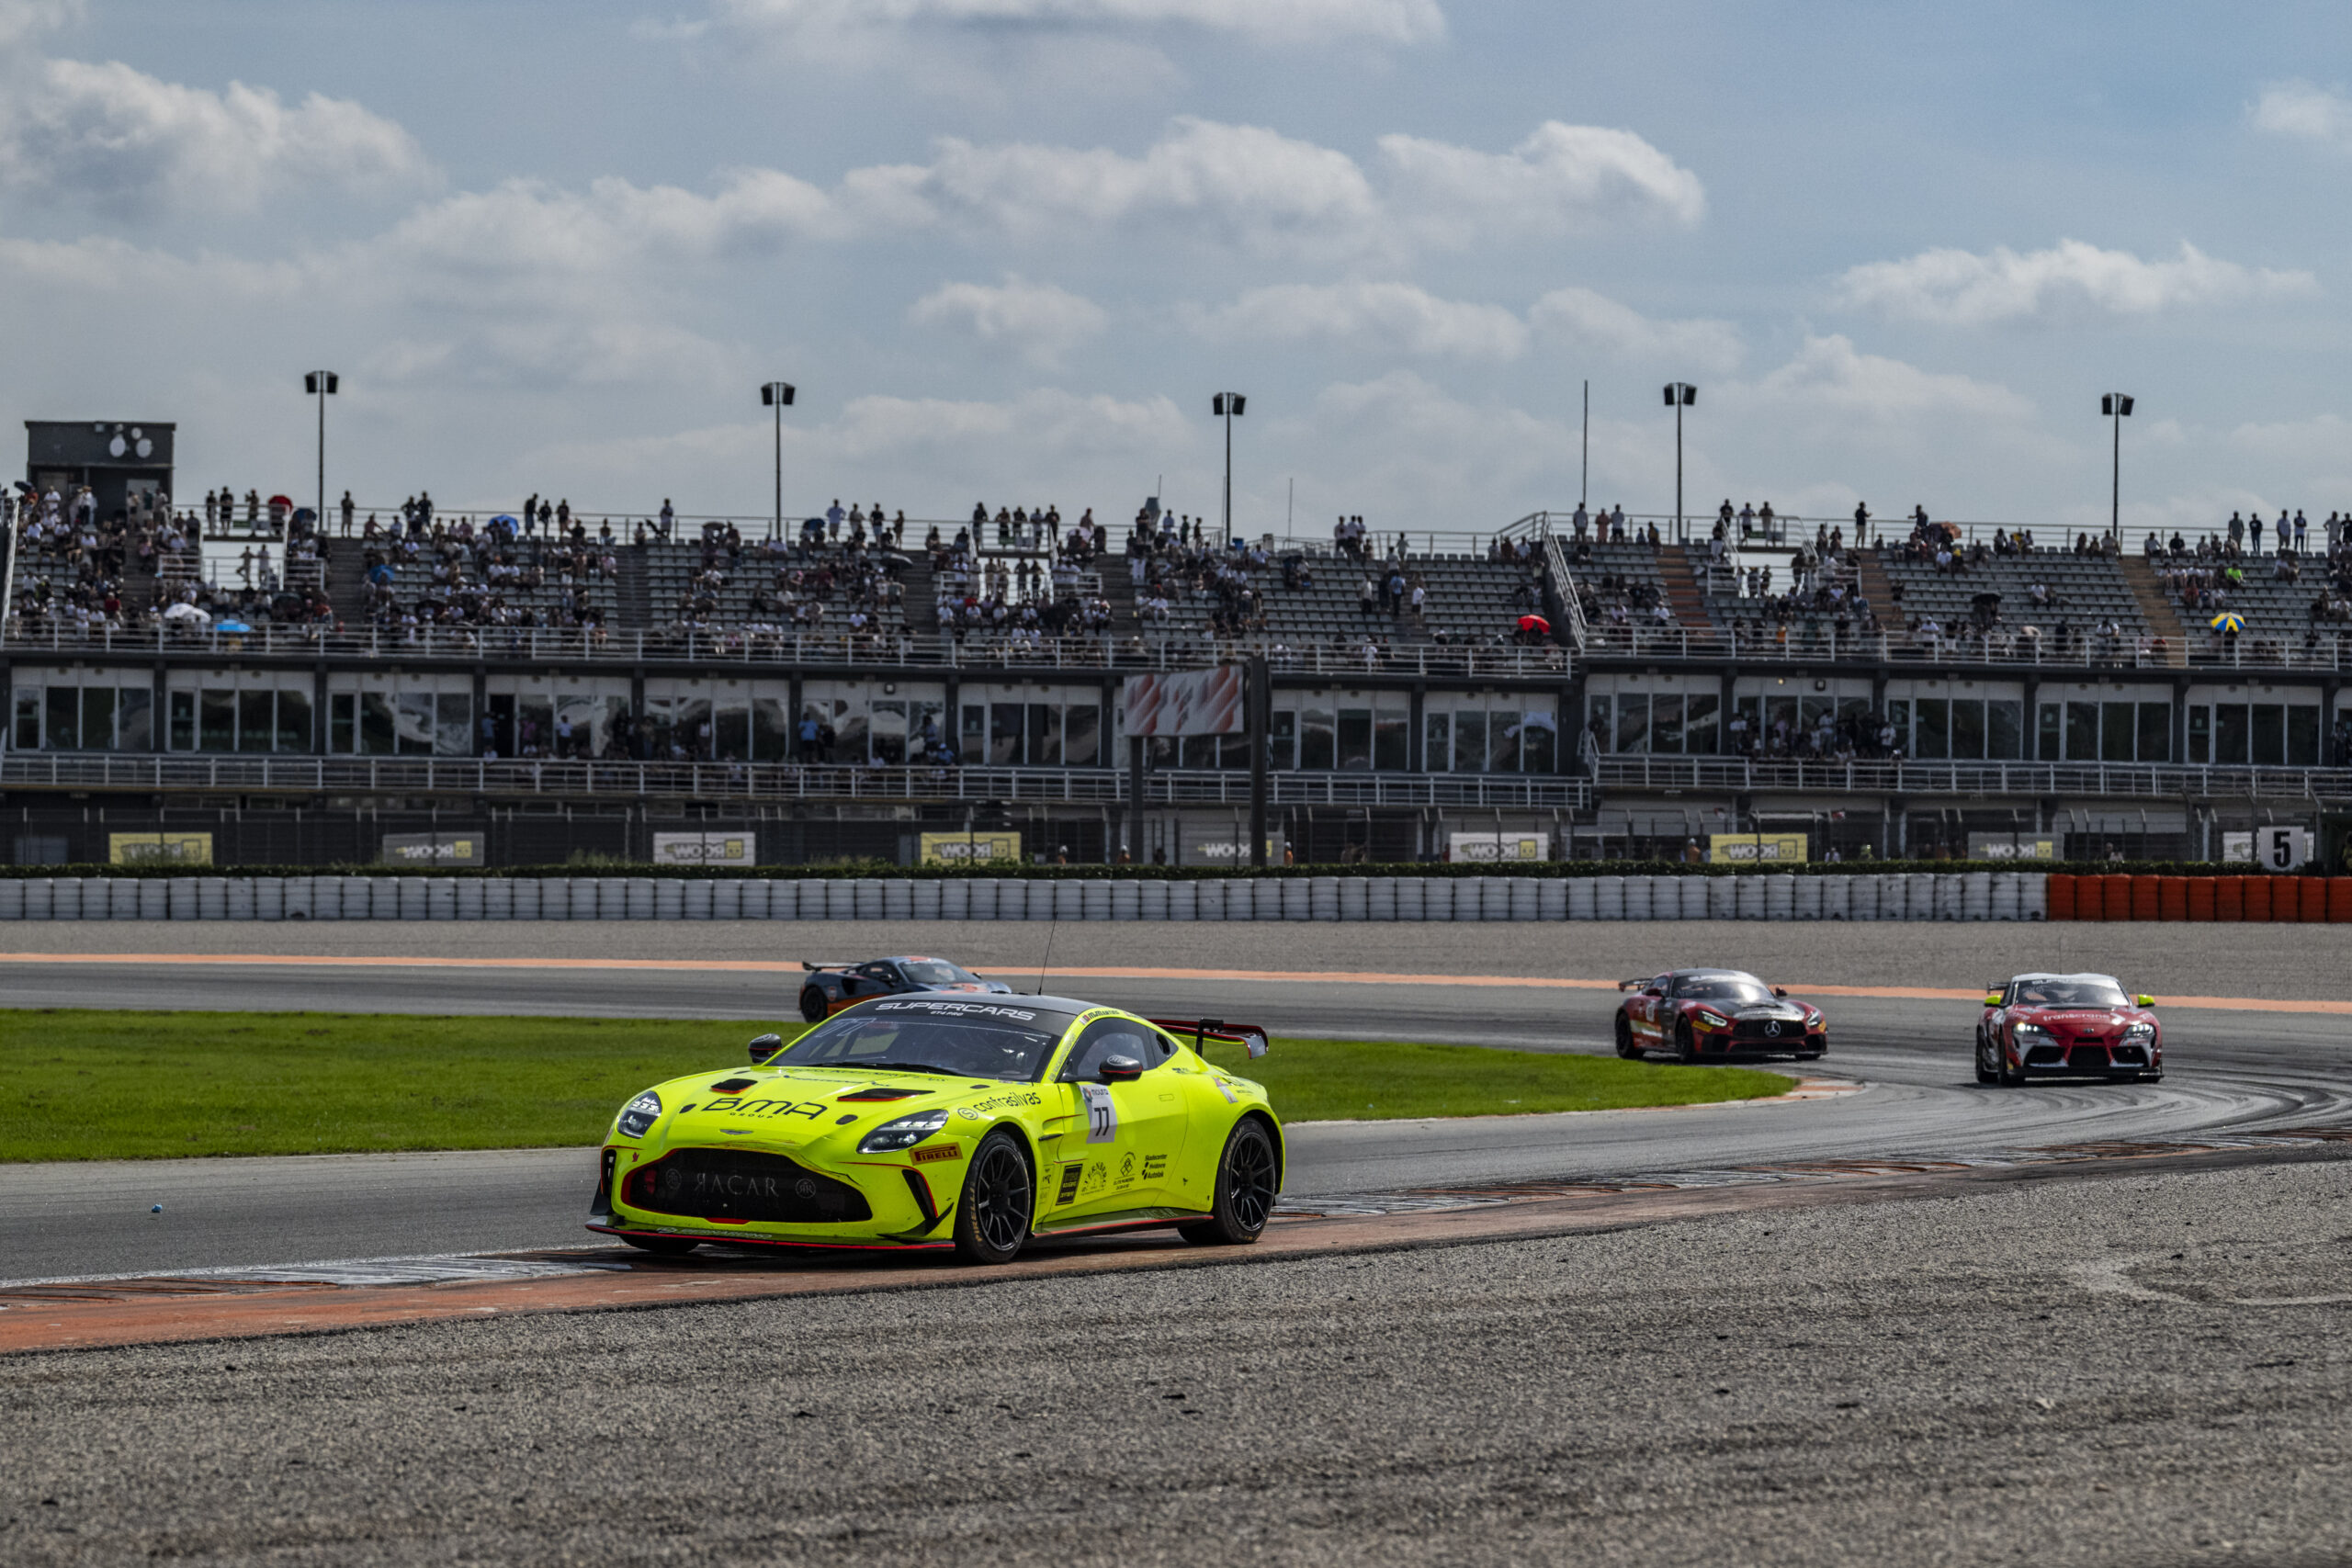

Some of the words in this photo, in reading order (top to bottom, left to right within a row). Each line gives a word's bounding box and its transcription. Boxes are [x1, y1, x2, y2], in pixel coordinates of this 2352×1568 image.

[2273, 830, 2290, 867] 5
[875, 1002, 1036, 1021] SUPERCARS
[701, 1097, 829, 1121] BMA
[1093, 1107, 1109, 1136] 77
[914, 1145, 958, 1162] PIRELLI
